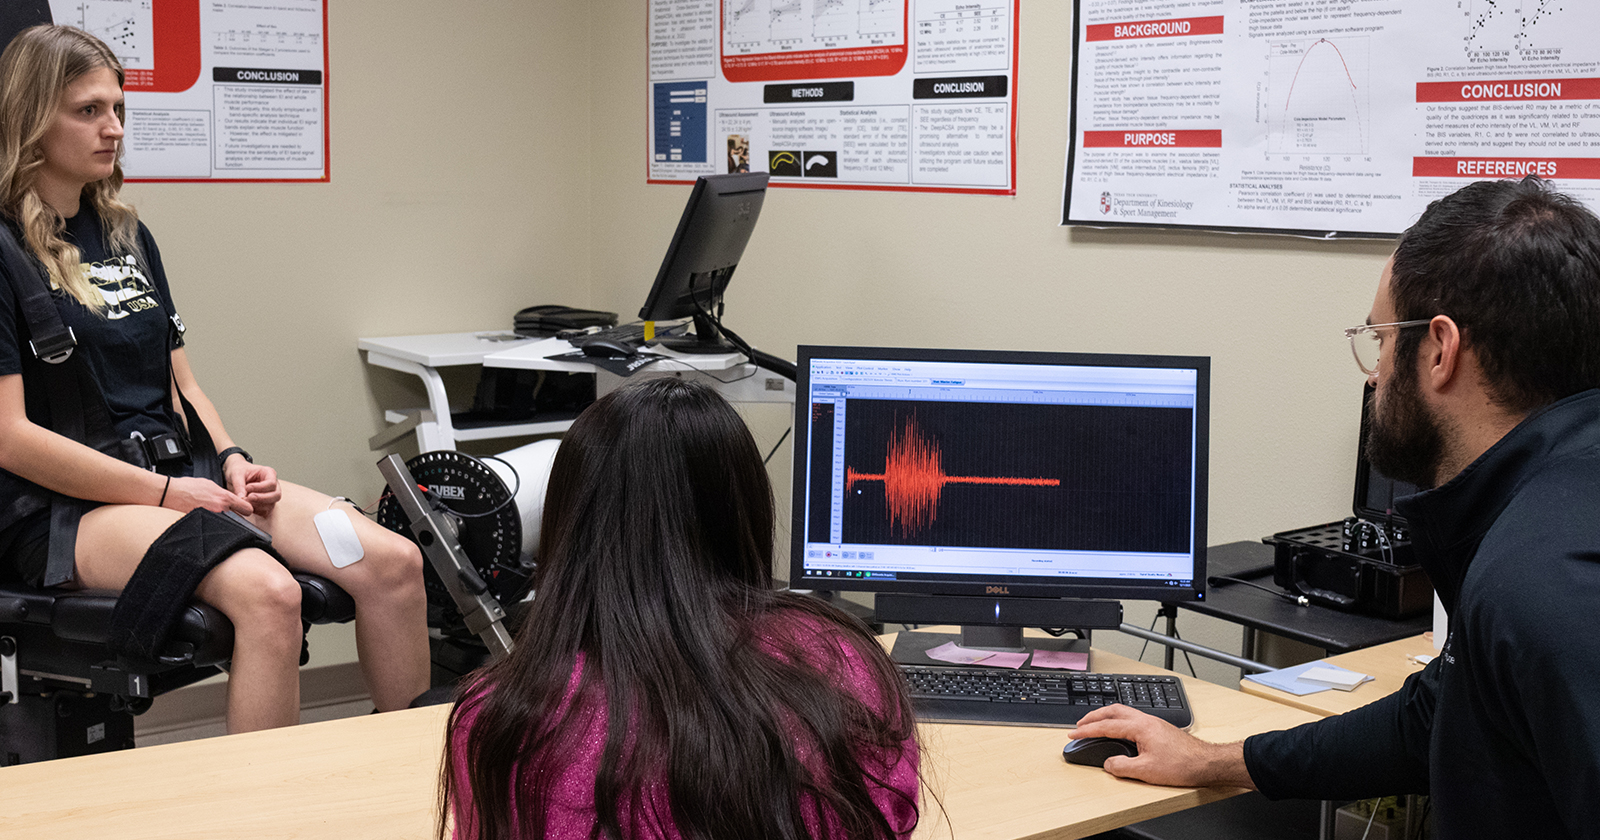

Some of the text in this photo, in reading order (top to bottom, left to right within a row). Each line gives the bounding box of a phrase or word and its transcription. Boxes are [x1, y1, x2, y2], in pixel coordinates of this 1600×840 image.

[1114, 22, 1191, 38] BACKGROUND
[236, 70, 299, 81] CONCLUSION
[792, 87, 824, 98] METHODS
[934, 82, 984, 93] CONCLUSION
[1461, 83, 1561, 98] CONCLUSION
[1124, 133, 1176, 145] PURPOSE
[1457, 161, 1557, 175] REFERENCES
[1114, 199, 1148, 207] Department
[1157, 199, 1193, 209] Kinesiology
[1120, 208, 1136, 216] Sport
[1138, 210, 1176, 218] Management
[126, 296, 159, 312] USA
[134, 676, 140, 695] 1
